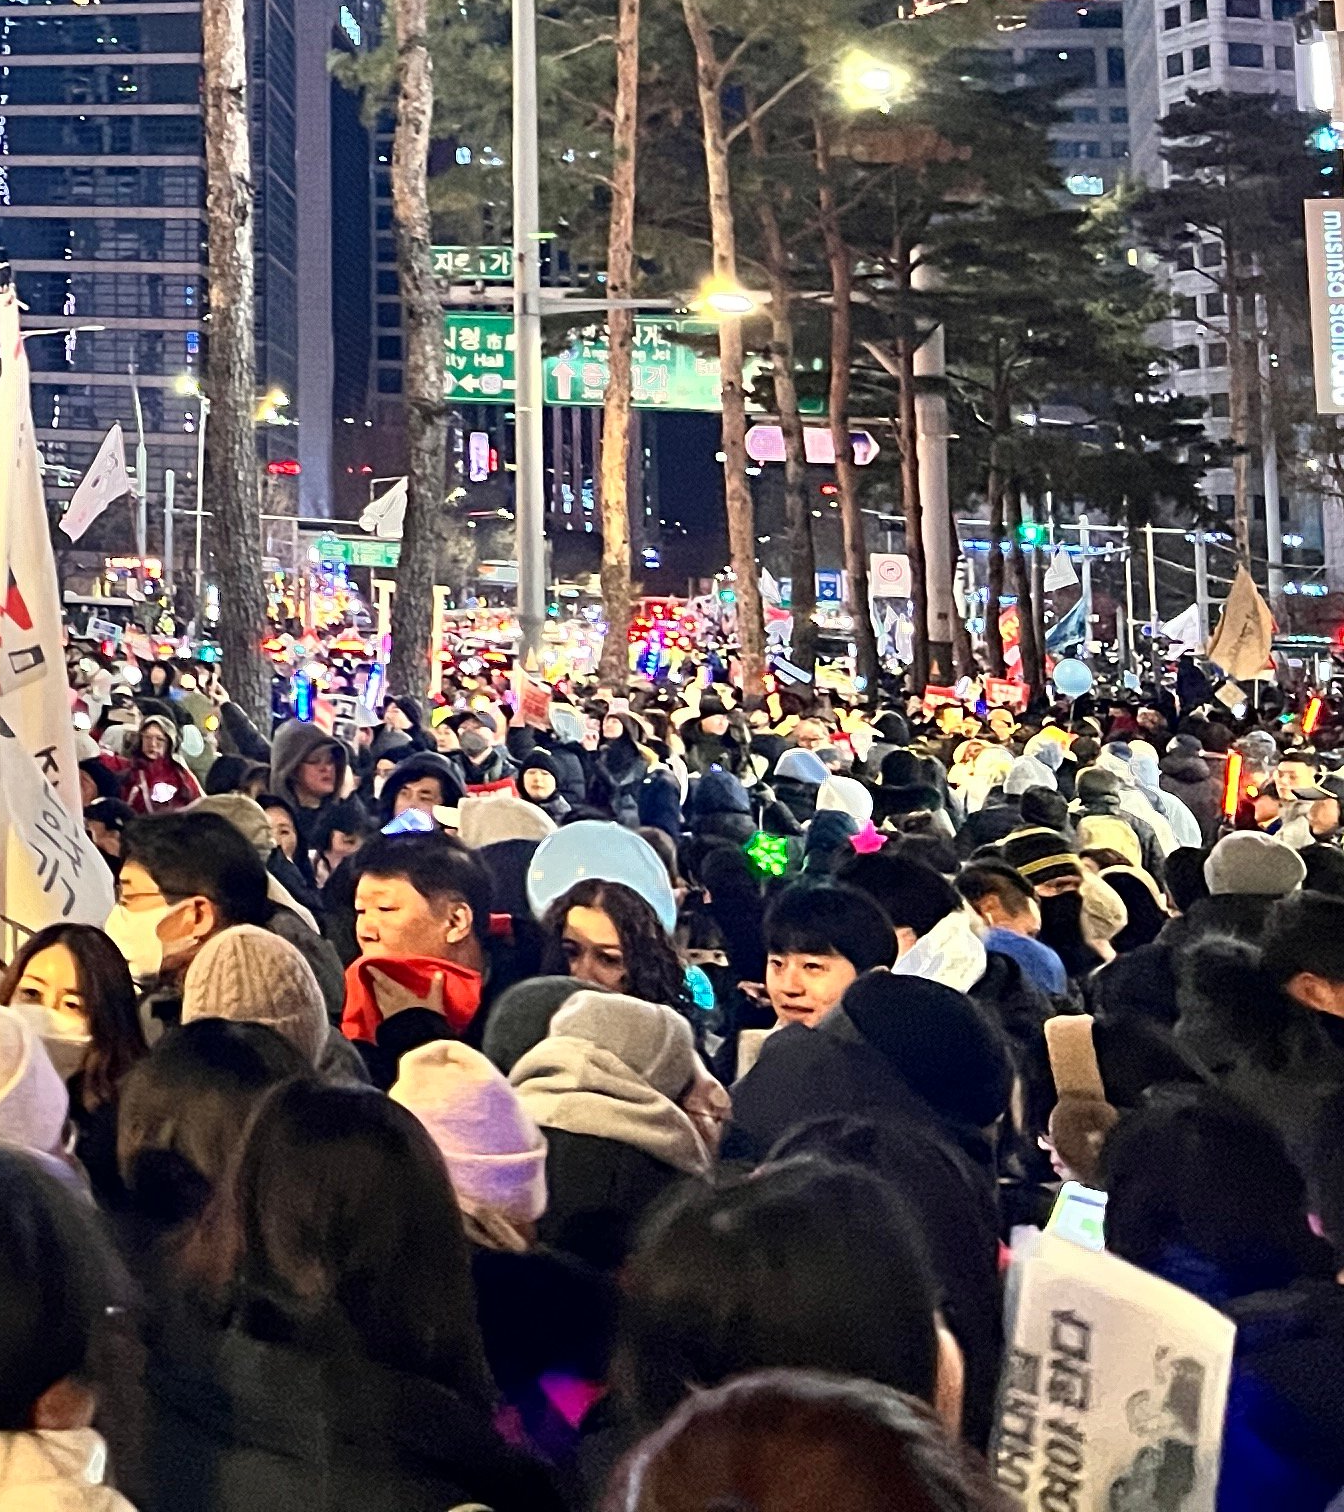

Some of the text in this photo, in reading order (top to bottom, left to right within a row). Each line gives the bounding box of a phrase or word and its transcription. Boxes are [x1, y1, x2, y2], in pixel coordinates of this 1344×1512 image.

[1322, 210, 1344, 298] musinsa
[444, 353, 505, 371] ity Hall
